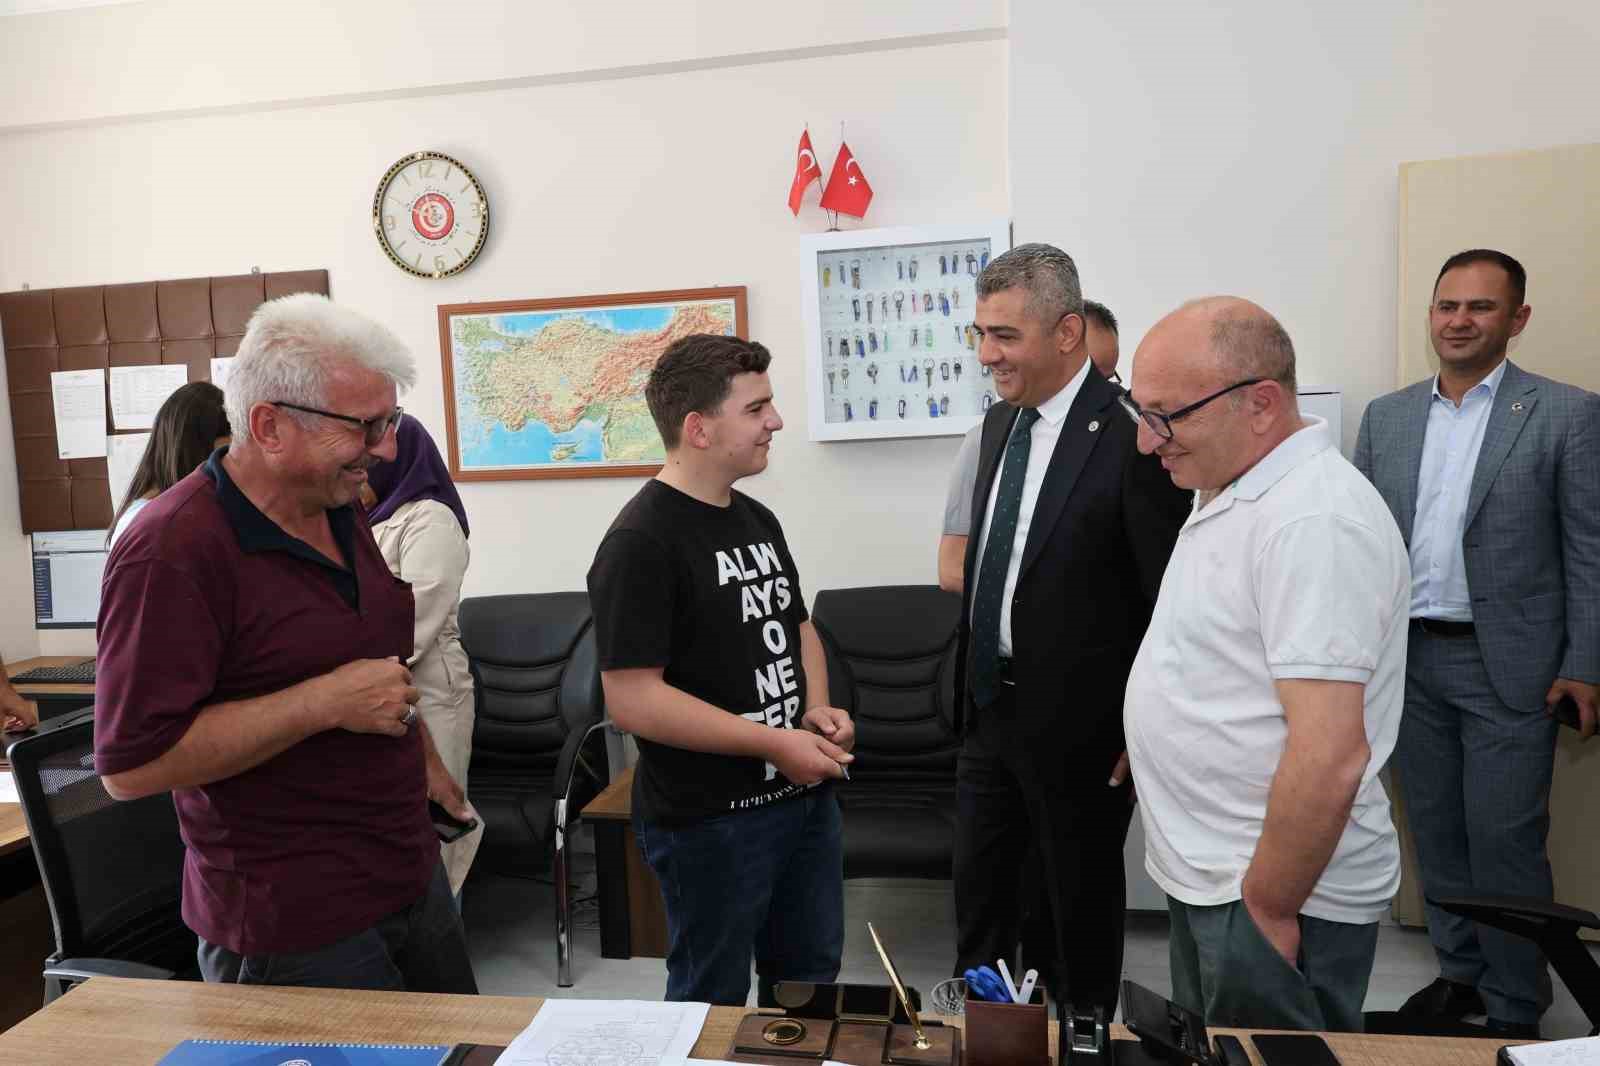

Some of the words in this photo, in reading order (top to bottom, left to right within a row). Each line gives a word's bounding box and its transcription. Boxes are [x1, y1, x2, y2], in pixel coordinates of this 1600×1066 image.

[418, 160, 434, 179] 12
[433, 256, 446, 271] 6
[715, 542, 782, 586] ALW
[742, 576, 791, 623] AYS
[762, 620, 787, 655] O
[755, 656, 798, 704] NE
